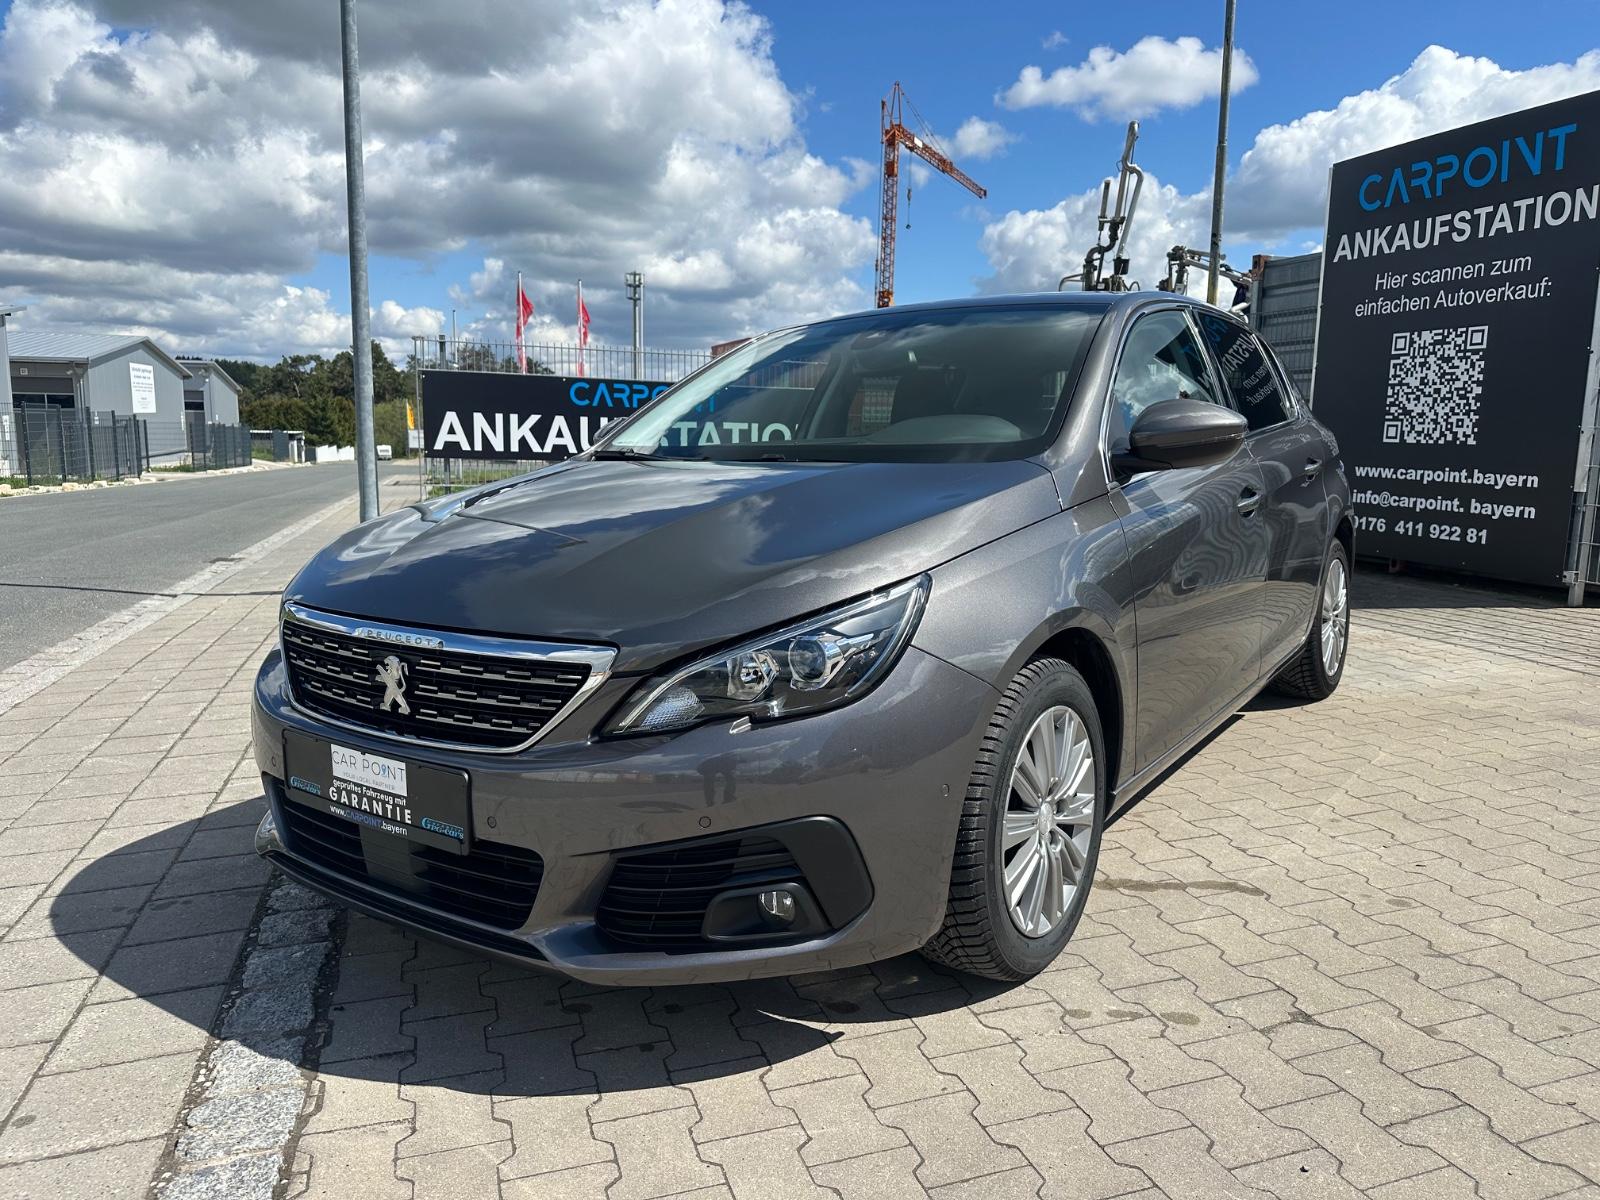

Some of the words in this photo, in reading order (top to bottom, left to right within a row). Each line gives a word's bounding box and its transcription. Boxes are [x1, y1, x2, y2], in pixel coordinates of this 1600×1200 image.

[1358, 123, 1577, 212] CARPOINT
[1333, 184, 1600, 263] ANKAUFSTATION
[1375, 272, 1408, 291] Hier
[1411, 262, 1484, 286] scannen
[1490, 255, 1532, 276] zum
[1355, 294, 1430, 317] einfachen
[1433, 277, 1552, 309] Autoverkauf:
[1355, 465, 1539, 490] www.carpoint.bayern
[1352, 489, 1464, 513] info@carpoint.
[1470, 499, 1536, 520] bayern
[1394, 520, 1424, 537] 411
[1429, 523, 1461, 541] 922
[1466, 528, 1488, 545] 81
[366, 629, 433, 646] PEUGEOT
[332, 750, 357, 770] CAR
[329, 786, 412, 824] GARANTIE
[362, 786, 393, 804] Fahrzeug
[394, 796, 406, 806] mit
